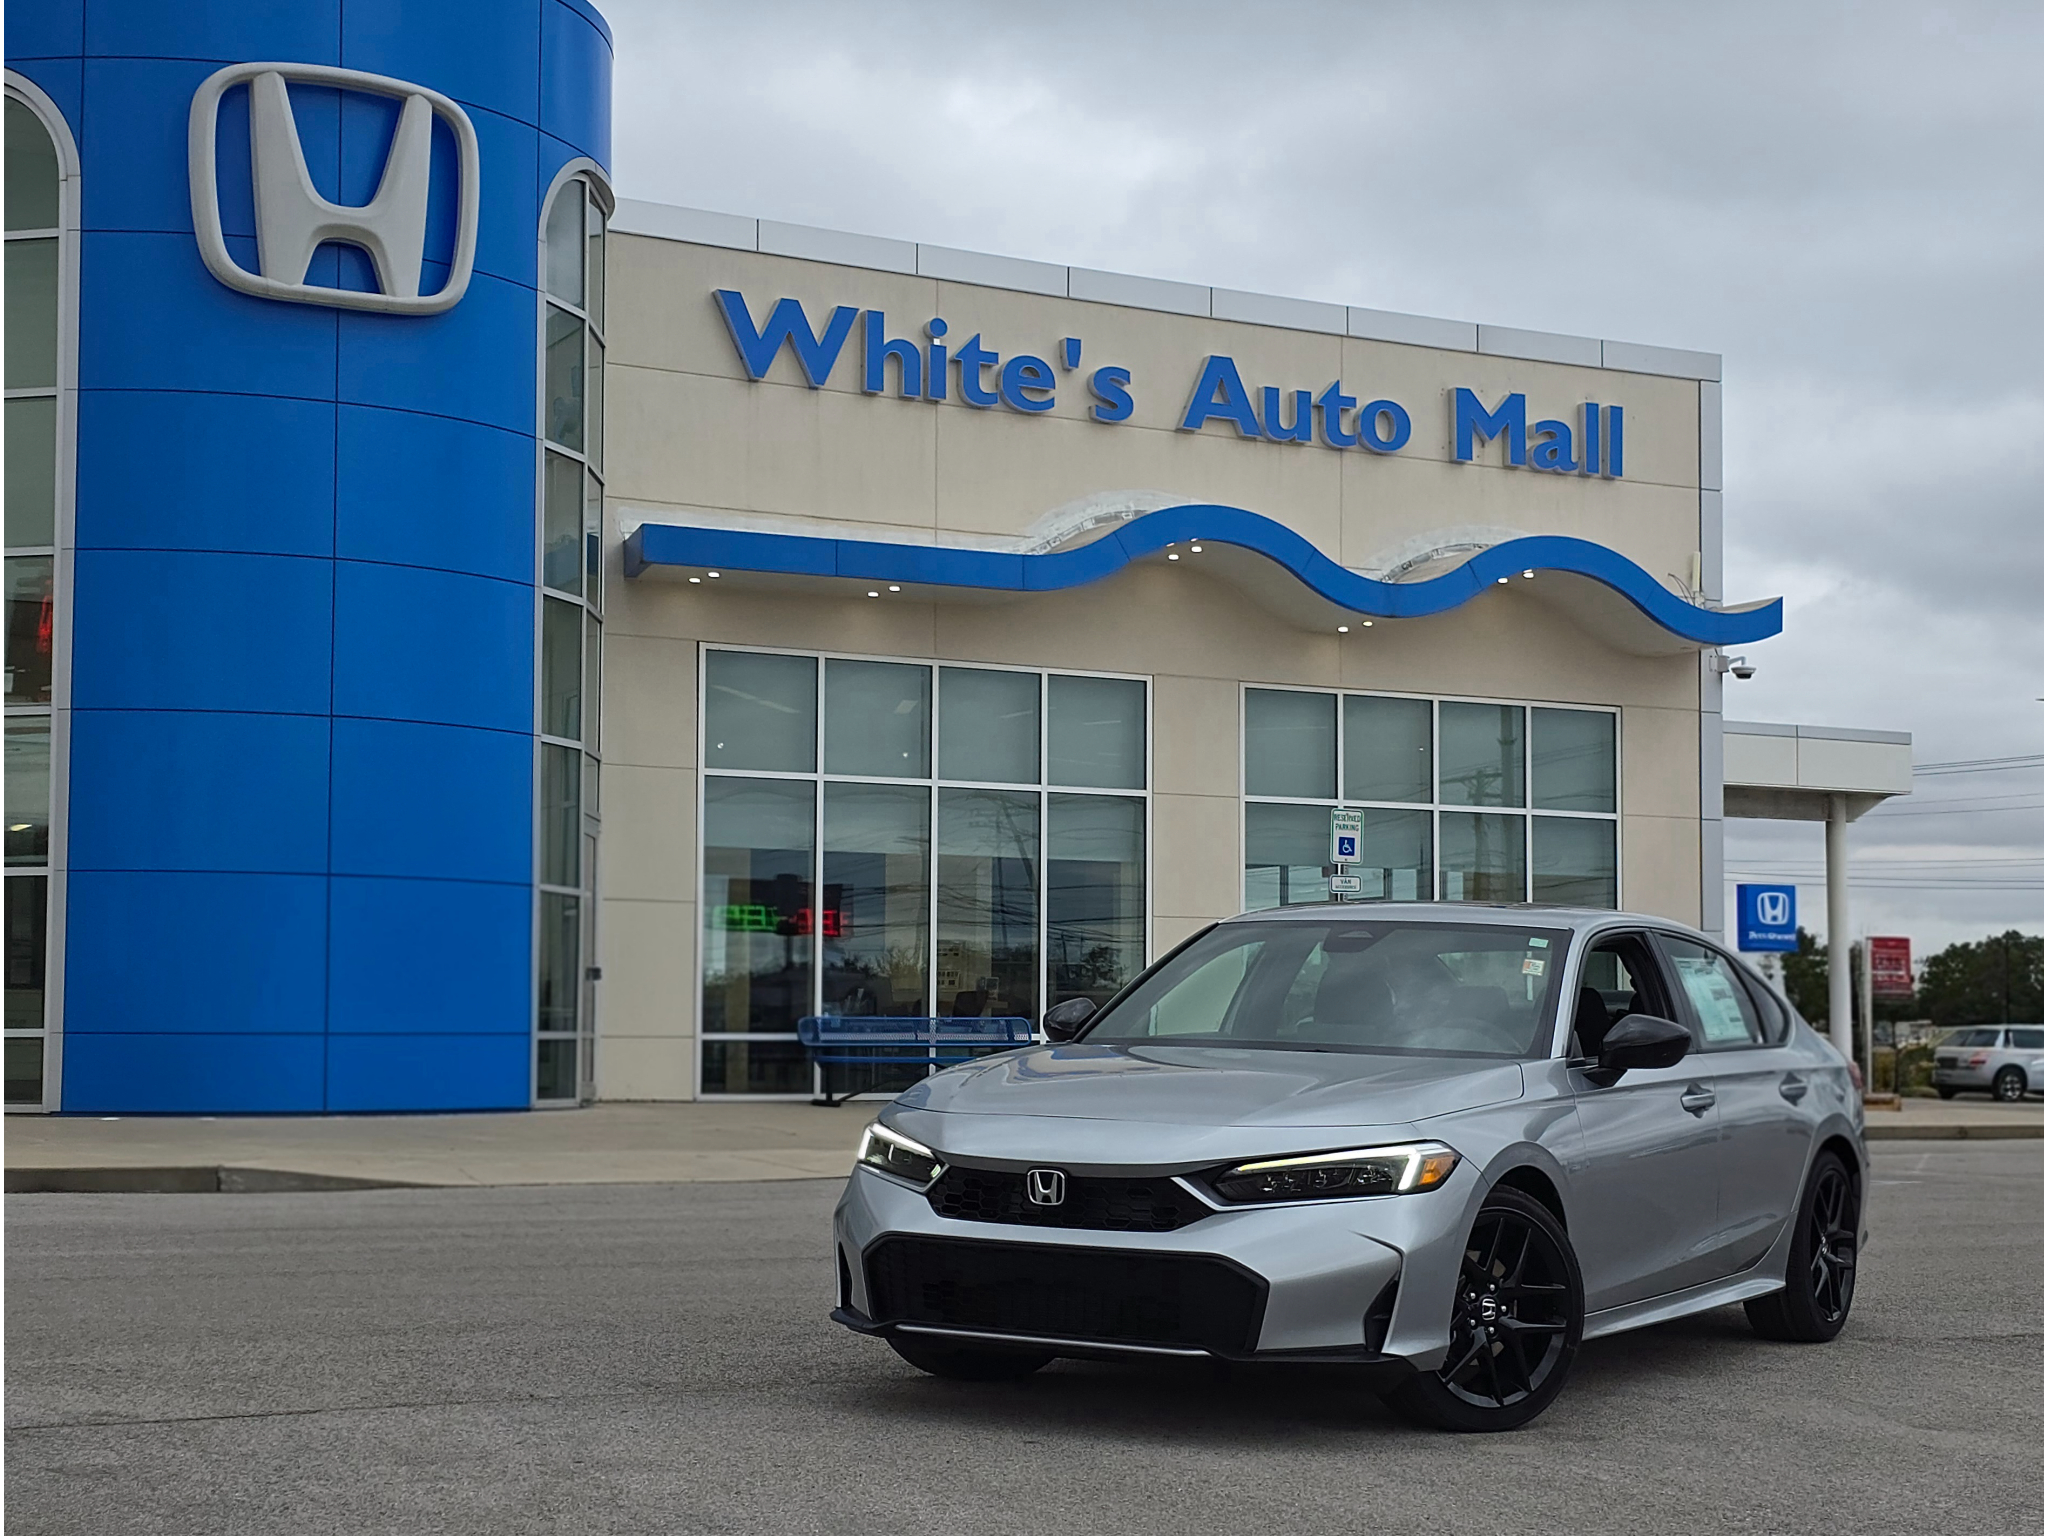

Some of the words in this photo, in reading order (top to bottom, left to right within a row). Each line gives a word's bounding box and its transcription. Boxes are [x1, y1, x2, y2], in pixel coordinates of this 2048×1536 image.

[713, 288, 1135, 424] White's
[1175, 354, 1412, 455] Auto
[1447, 386, 1624, 479] Mall
[1335, 823, 1360, 832] PARKING
